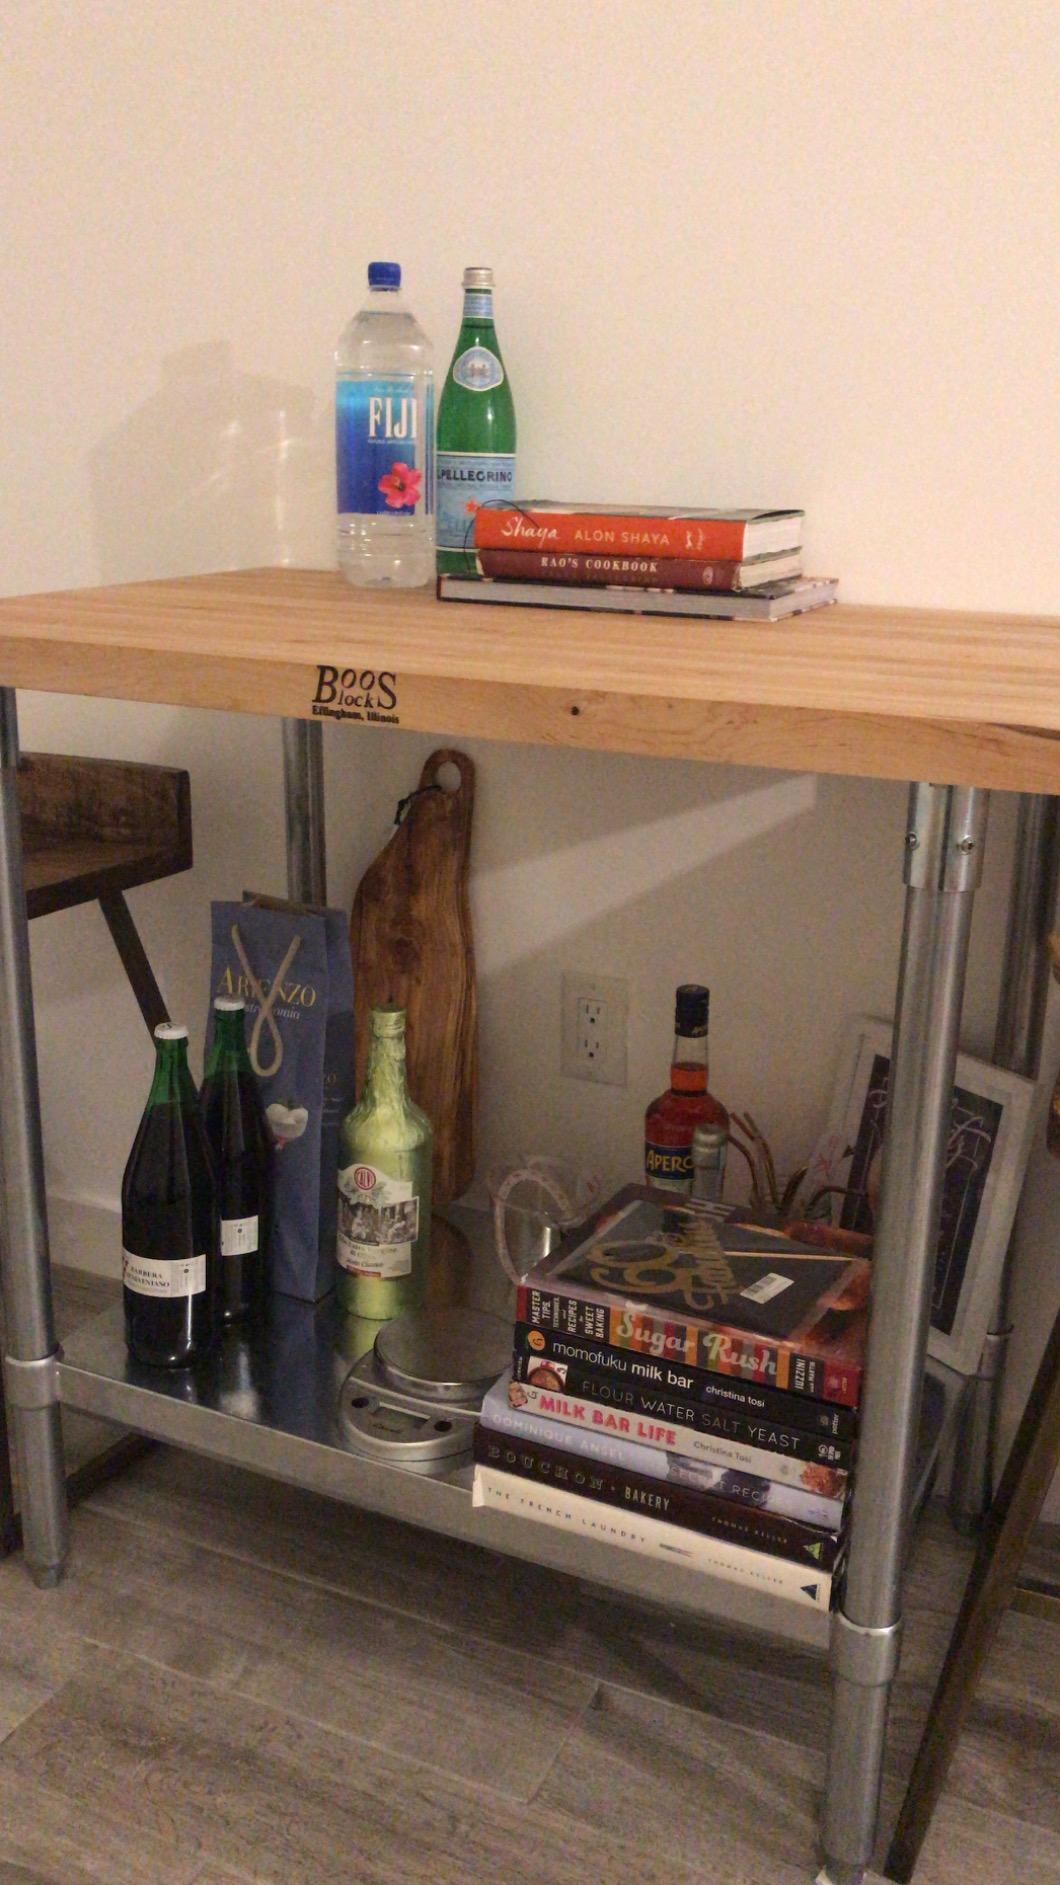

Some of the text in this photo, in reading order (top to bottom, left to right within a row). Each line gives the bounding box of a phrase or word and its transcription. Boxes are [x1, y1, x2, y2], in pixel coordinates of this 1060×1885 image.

[368, 397, 418, 439] FIJI
[501, 516, 560, 548] Shaya
[574, 529, 670, 545] ALON SHAYA
[541, 556, 658, 573] RAO'S COOKBOOK
[531, 1290, 541, 1324] MASTER
[567, 1299, 577, 1333] RECIPES
[584, 1305, 594, 1335] SWEET
[595, 1307, 605, 1339] BAKING
[616, 1310, 777, 1375] Sugar Rush
[553, 1342, 694, 1389] momofuku milk bar
[705, 1385, 765, 1408] christina tosi
[539, 1395, 676, 1446] MILK BAR LIFE
[582, 1380, 800, 1450] FLOUR WATER SALT YEAST
[492, 1413, 623, 1459] DOMINIQUE ANSEL
[693, 1440, 733, 1458] Christina
[488, 1486, 646, 1543] THE FRENCH LAUNDRY
[624, 1486, 670, 1512] BAKERY
